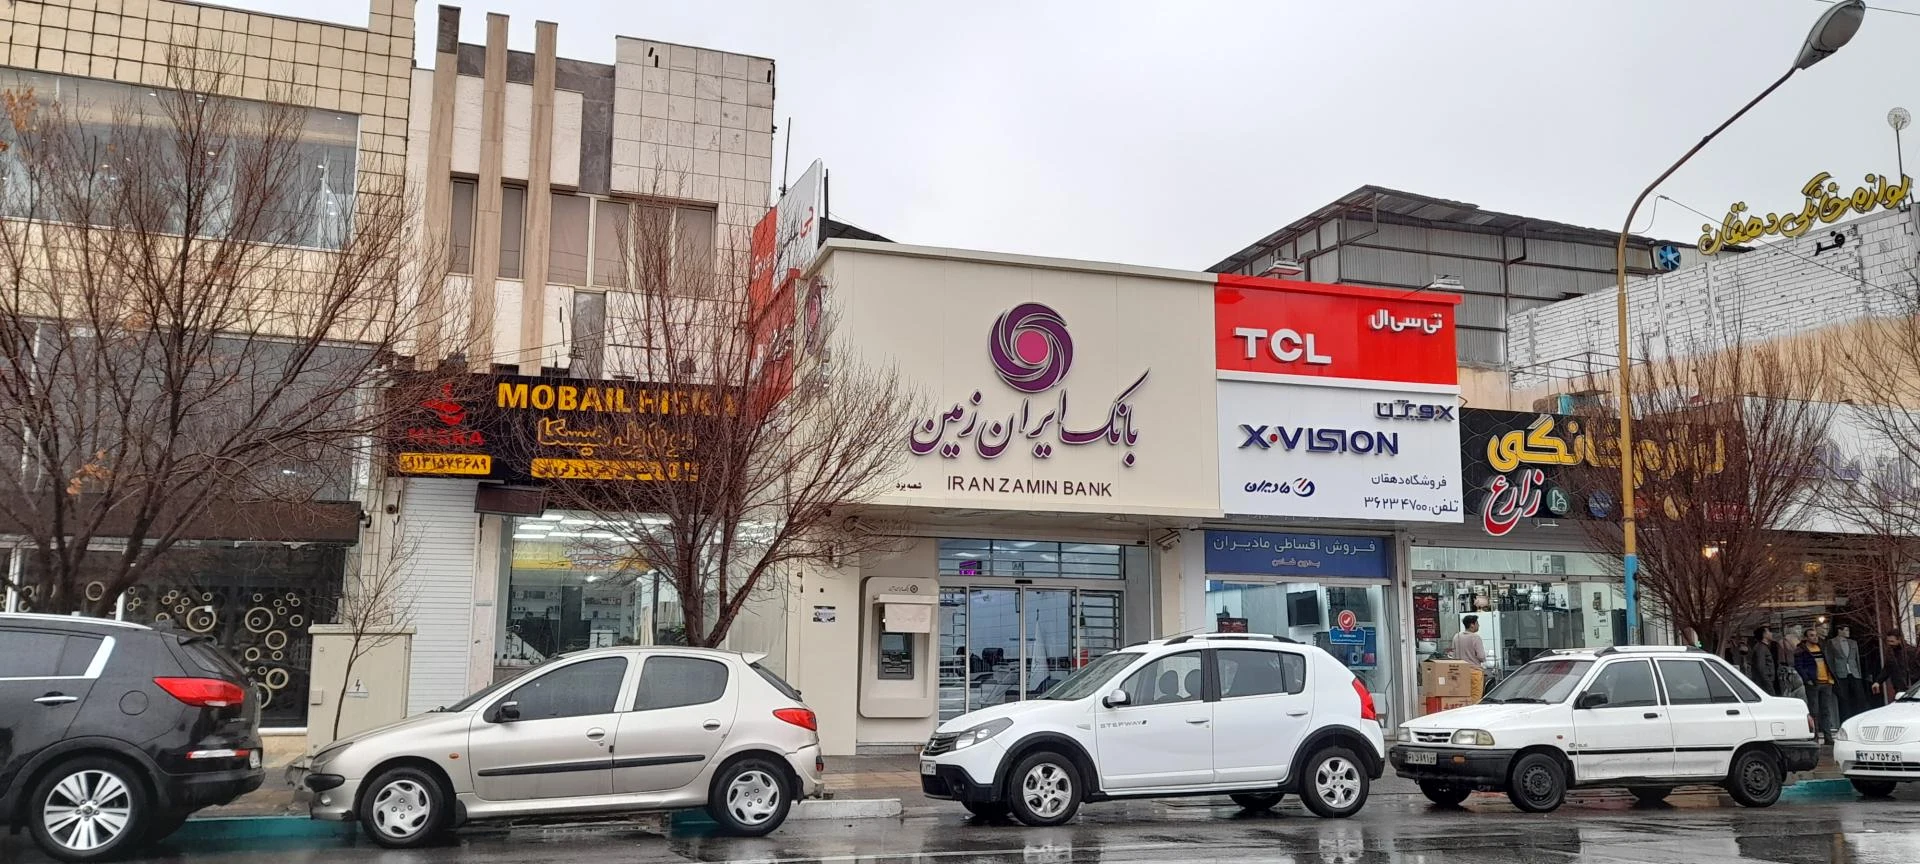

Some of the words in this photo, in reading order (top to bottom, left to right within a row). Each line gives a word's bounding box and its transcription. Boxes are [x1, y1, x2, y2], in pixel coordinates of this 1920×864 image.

[1698, 201, 1779, 256] دهقان
[1233, 326, 1332, 364] TCL
[497, 382, 632, 413] MOBAIL
[908, 388, 982, 458] زمین
[976, 388, 1068, 460] ایران
[1059, 366, 1151, 468] بانک
[947, 475, 995, 492] IRAN
[998, 478, 1058, 495] ZAMIN
[1062, 480, 1113, 497] BANK
[1244, 479, 1291, 495] مادیران
[1371, 473, 1405, 485] دهقان
[1405, 474, 1448, 490] فروشگاه
[1484, 468, 1546, 537] زارع
[1213, 535, 1270, 551] مادیران
[1274, 538, 1321, 553] اقساطی
[1325, 539, 1376, 555] فروش
